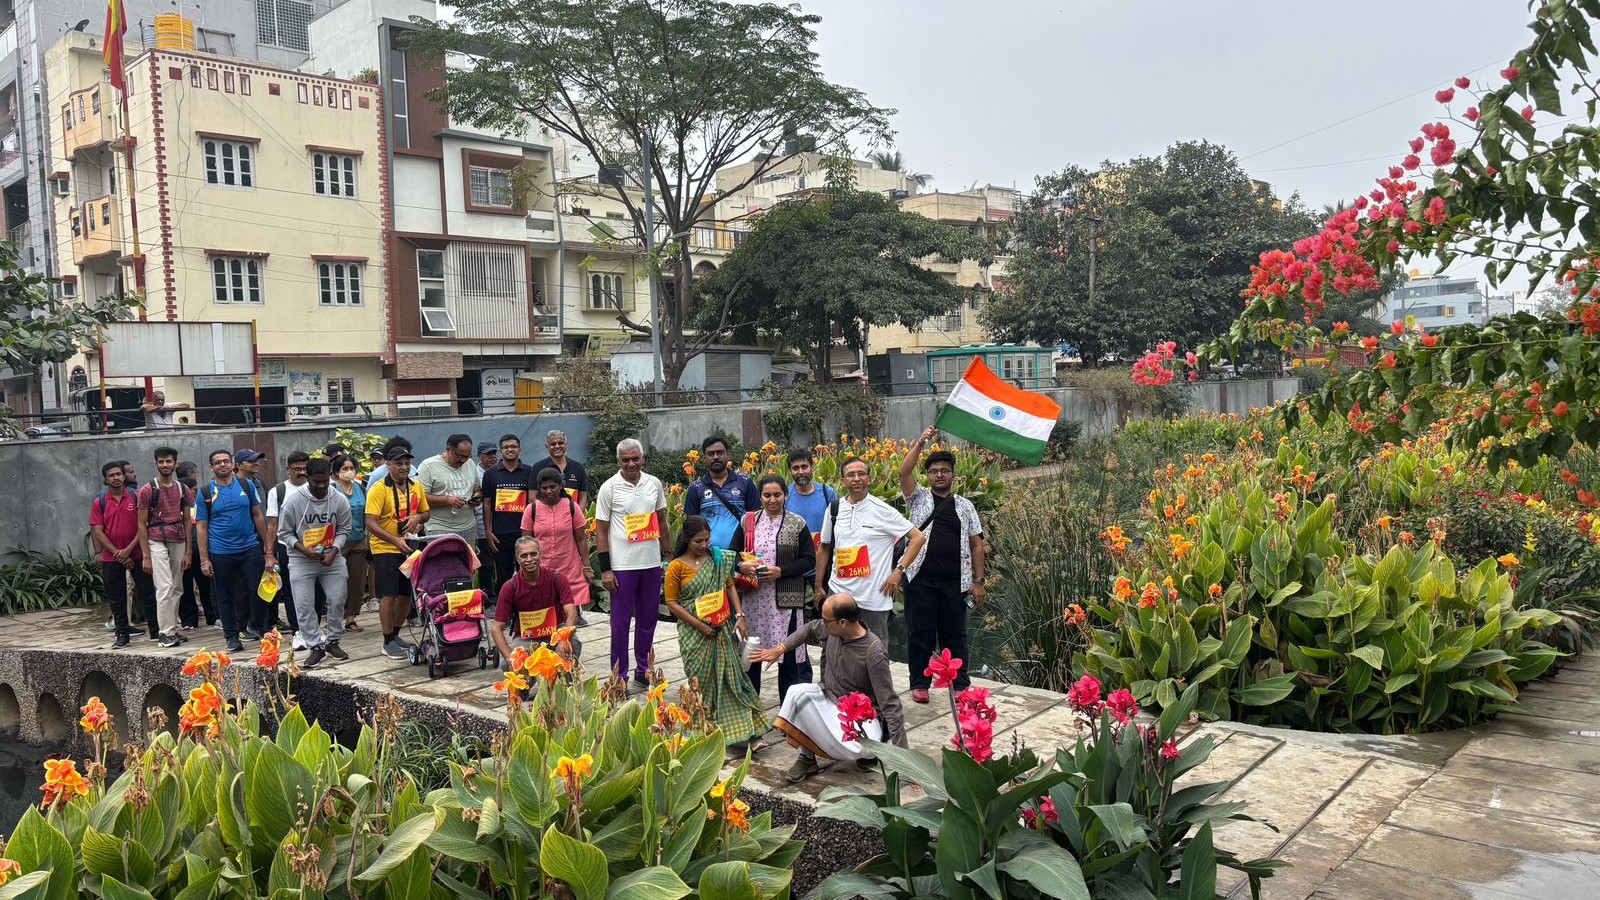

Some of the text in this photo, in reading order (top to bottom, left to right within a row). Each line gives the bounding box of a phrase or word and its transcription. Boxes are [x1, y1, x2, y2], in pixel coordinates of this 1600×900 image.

[508, 504, 525, 512] 26KM
[301, 512, 337, 524] NASA
[642, 530, 659, 539] 26KM
[849, 565, 870, 576] 26KM
